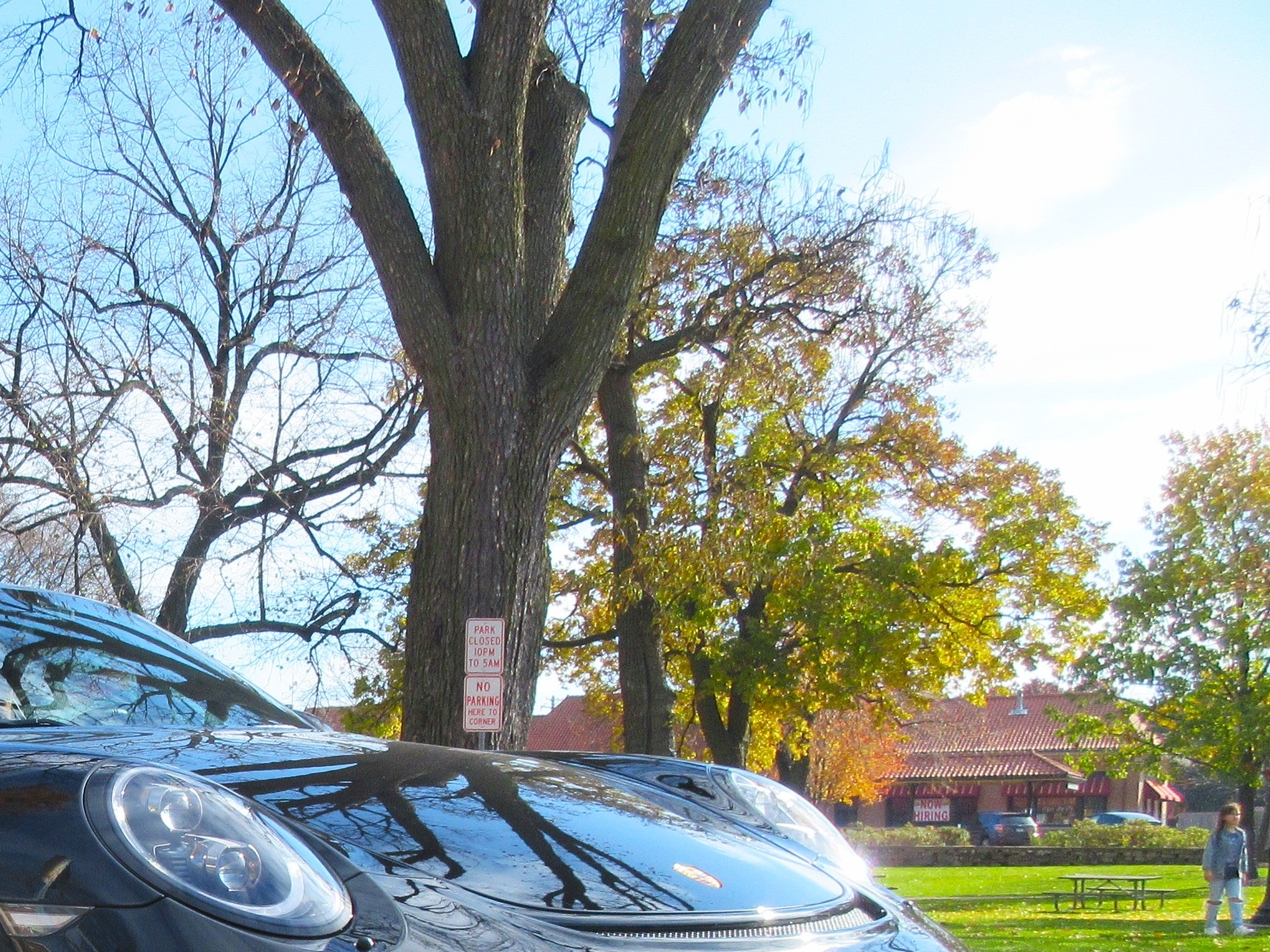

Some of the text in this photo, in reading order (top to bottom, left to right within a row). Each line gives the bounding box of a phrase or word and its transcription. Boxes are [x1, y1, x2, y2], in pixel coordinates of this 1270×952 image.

[474, 625, 496, 634] PARK
[468, 636, 501, 646] CLOSED
[474, 647, 495, 657] 10PM
[468, 658, 501, 668] TO 5AM
[476, 681, 491, 692] NO
[466, 695, 500, 706] PARKING
[467, 708, 498, 716] HERE TO
[469, 717, 496, 726] CORNER
[920, 800, 941, 809] NOW
[913, 810, 949, 821] HIRING
